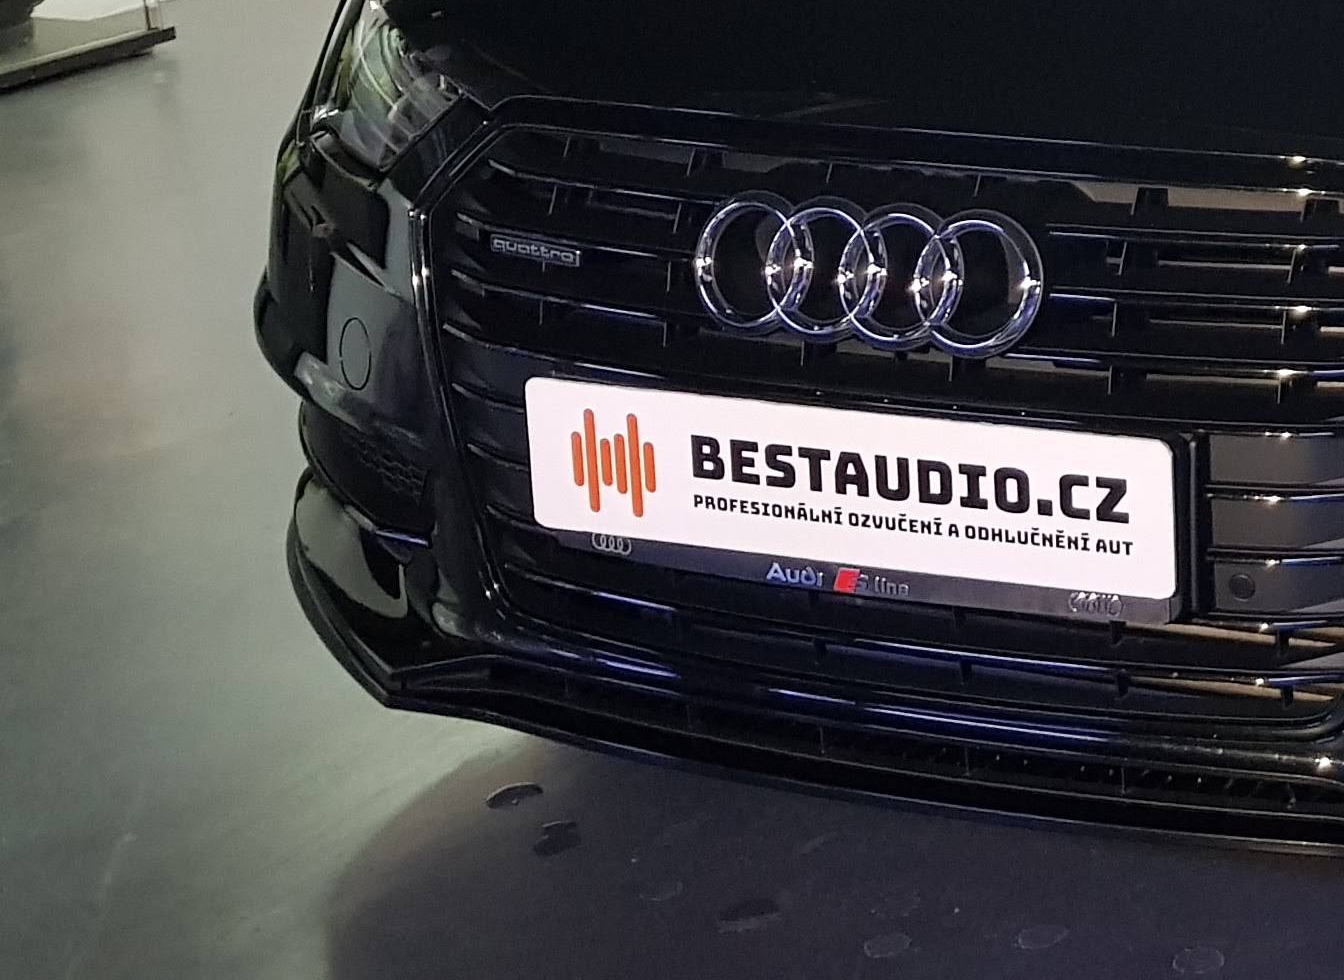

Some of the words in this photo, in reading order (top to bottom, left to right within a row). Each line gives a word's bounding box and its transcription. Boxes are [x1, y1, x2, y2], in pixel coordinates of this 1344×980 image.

[493, 239, 574, 262] quattro
[691, 434, 1130, 524] BESTAUDIO.CZ
[693, 494, 844, 525] PROFESIONÁLNÍ
[849, 513, 943, 536] OZVUČENÍ
[948, 523, 960, 538] A
[965, 525, 1091, 552] ODHLUČNĚNÍ
[1096, 538, 1134, 556] AUT
[766, 562, 824, 587] Audi
